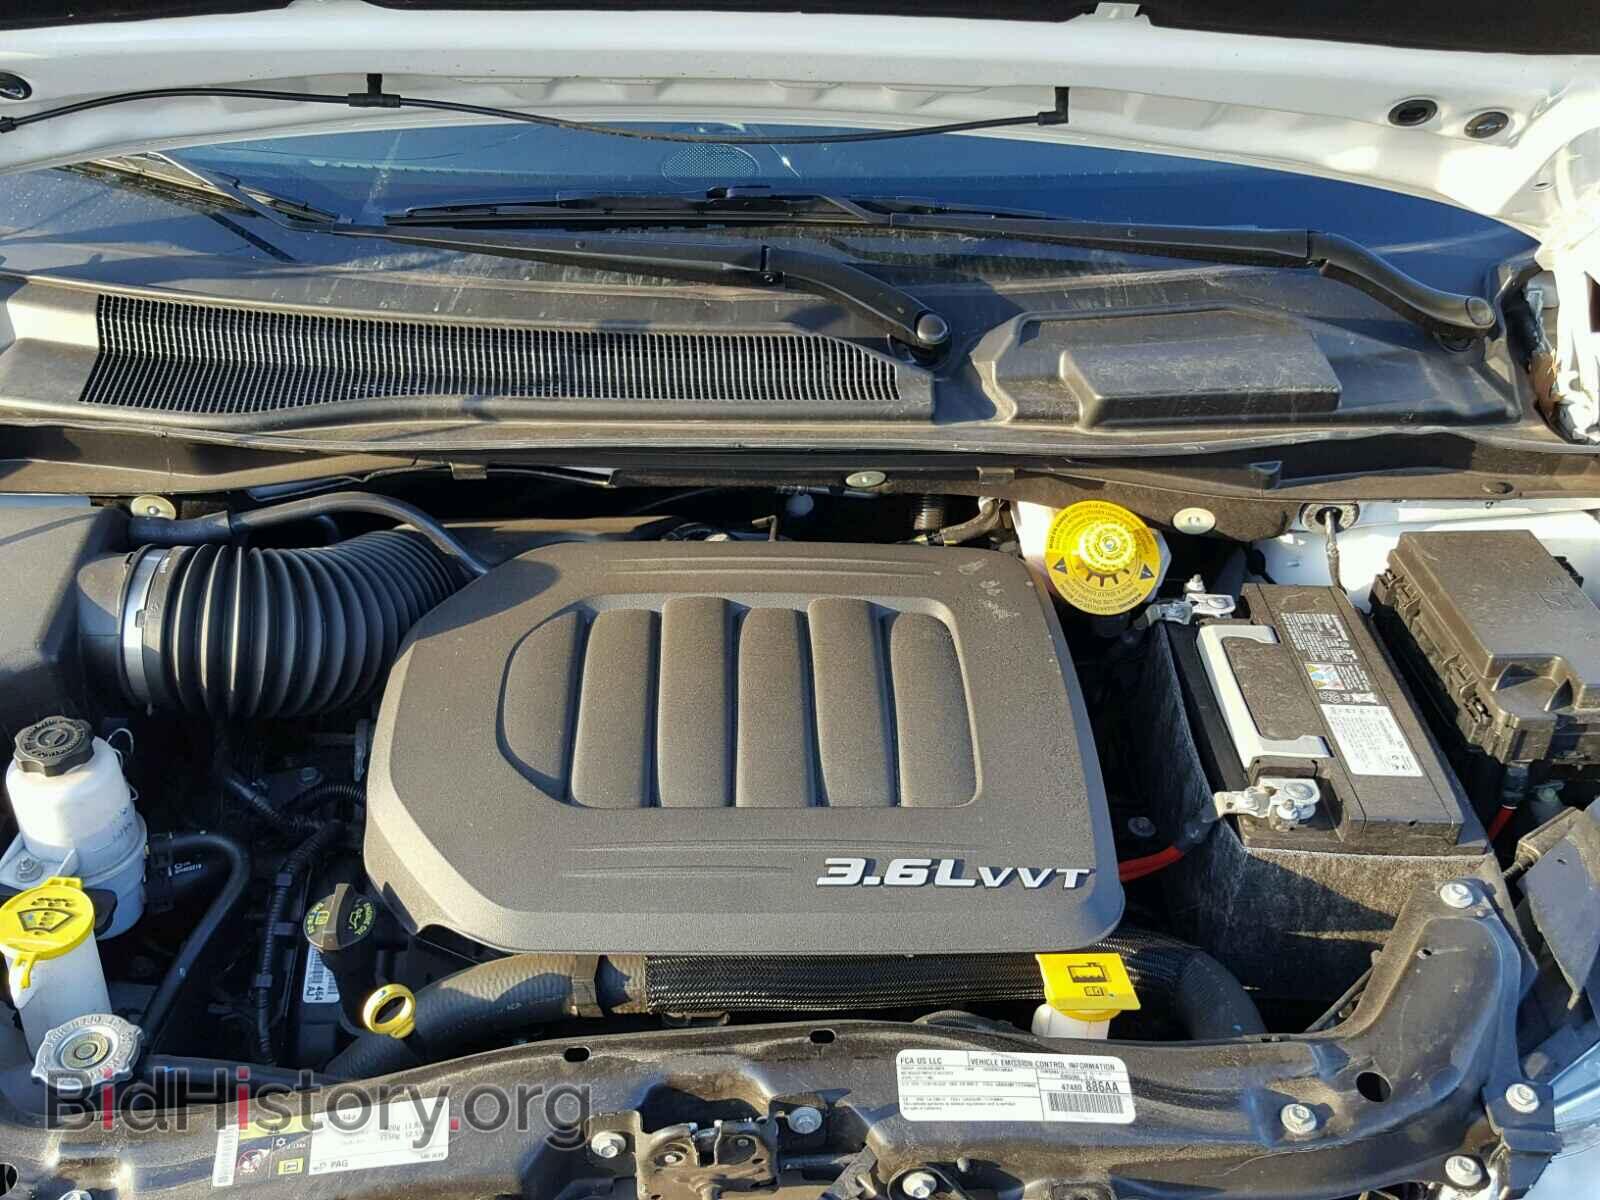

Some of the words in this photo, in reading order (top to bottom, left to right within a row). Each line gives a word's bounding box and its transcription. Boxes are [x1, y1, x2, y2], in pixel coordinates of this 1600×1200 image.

[900, 1057, 915, 1065] FCA
[916, 1057, 928, 1065] US
[929, 1057, 943, 1065] LLC
[970, 1058, 999, 1067] VEHICLE
[1000, 1058, 1034, 1068] EMISSION
[1035, 1060, 1067, 1070] CONTROL
[1069, 1061, 1116, 1071] INFORMATION
[329, 1158, 349, 1169] PAG
